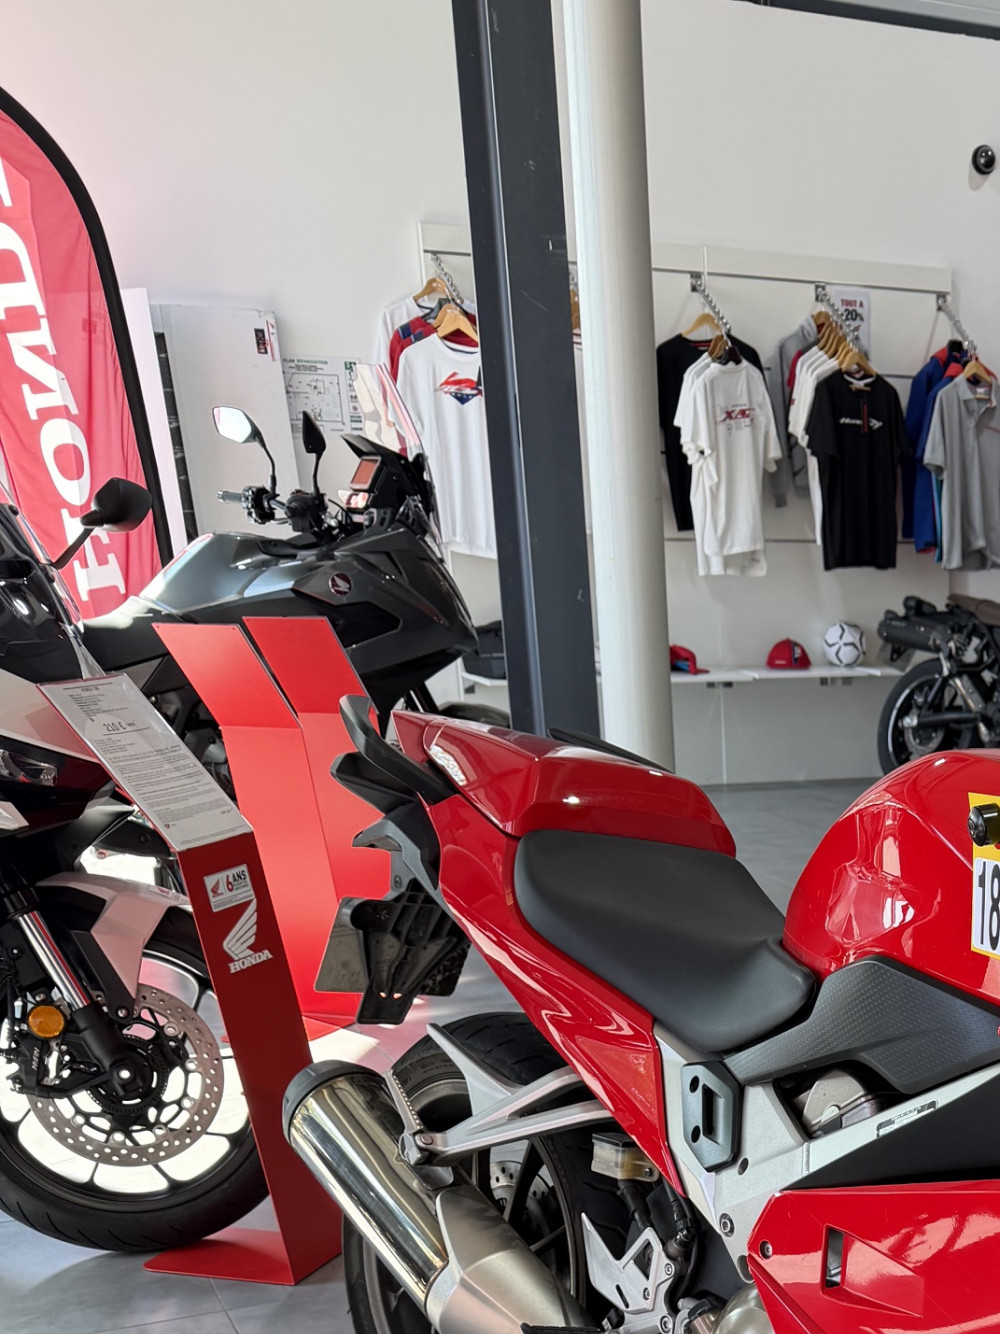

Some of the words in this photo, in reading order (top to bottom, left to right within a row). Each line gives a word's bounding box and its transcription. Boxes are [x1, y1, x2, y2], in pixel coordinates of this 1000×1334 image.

[0, 155, 127, 603] HOND
[226, 874, 235, 893] 6
[232, 869, 247, 884] ANS
[228, 949, 274, 974] HONDA
